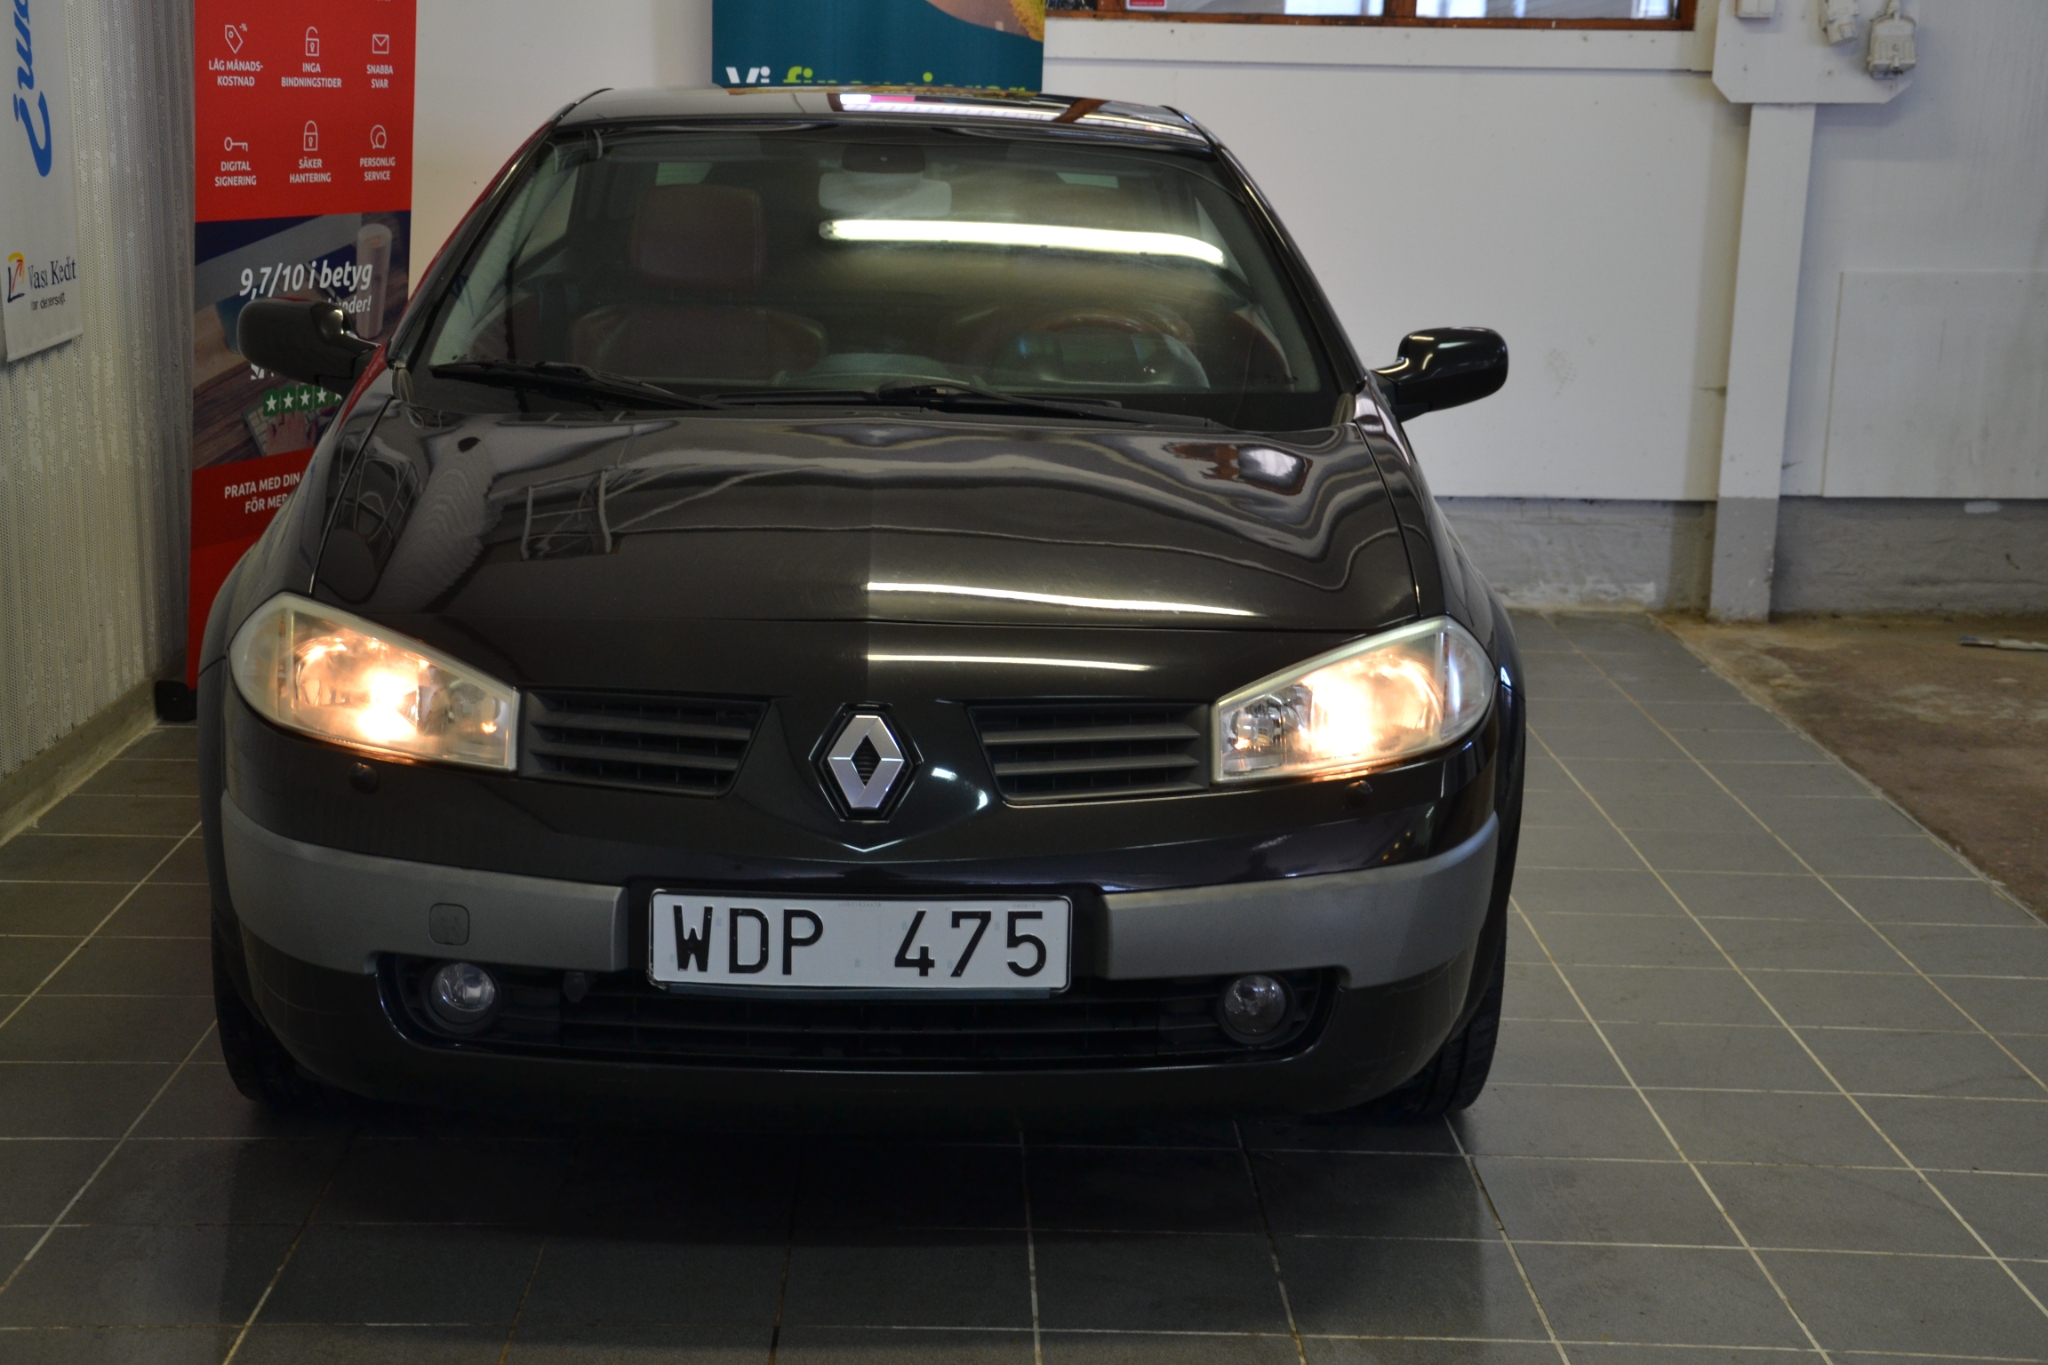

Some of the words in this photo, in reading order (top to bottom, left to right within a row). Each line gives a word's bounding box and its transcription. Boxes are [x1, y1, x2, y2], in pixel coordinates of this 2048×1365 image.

[208, 58, 225, 71] LÅG
[226, 58, 263, 72] MÅNADS-
[302, 62, 321, 73] INGA
[366, 64, 393, 75] SNABBA
[217, 75, 255, 87] KOSTNAD
[281, 77, 342, 88] BINDNINGSTIDER
[371, 78, 389, 88] SVAR
[220, 160, 251, 172] DIGITAL
[298, 156, 322, 169] SÄKER
[359, 156, 395, 167] PERSONLIG
[214, 175, 257, 187] SIGNERING
[289, 173, 331, 184] HANTERING
[364, 171, 391, 181] SERVICE
[239, 262, 304, 300] 9,7/10
[308, 260, 317, 290] i
[319, 259, 373, 292] betyg
[224, 480, 257, 499] PRATA
[258, 476, 281, 492] MED
[282, 472, 301, 487] DIN
[244, 496, 265, 514] FÖR
[672, 904, 824, 976] WDP
[893, 909, 1048, 979] 475
